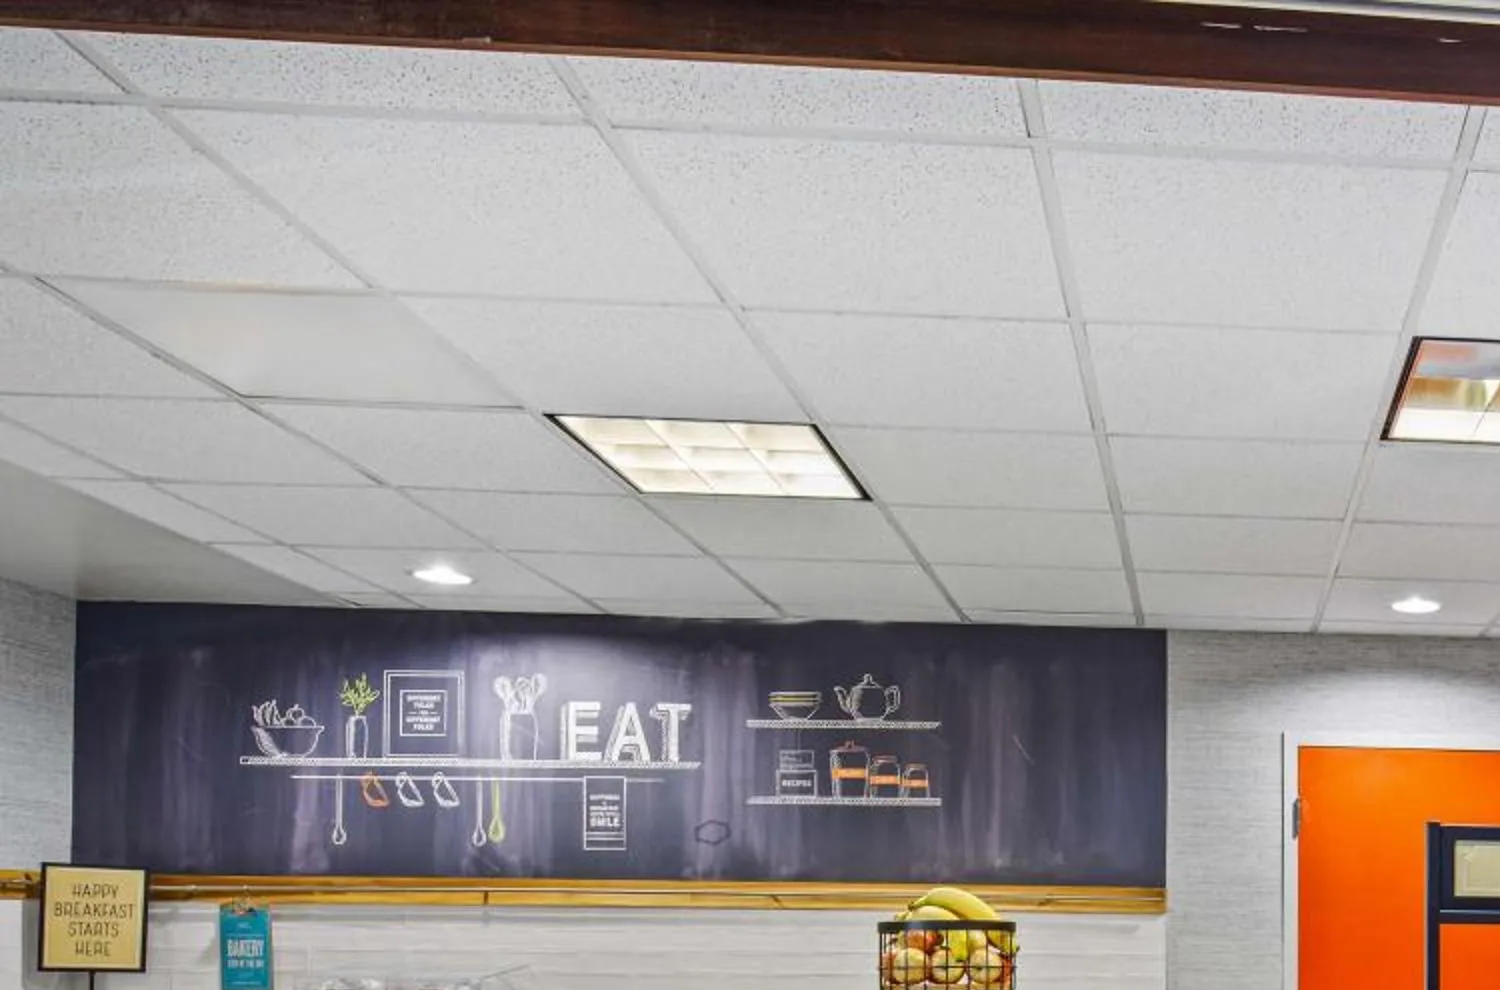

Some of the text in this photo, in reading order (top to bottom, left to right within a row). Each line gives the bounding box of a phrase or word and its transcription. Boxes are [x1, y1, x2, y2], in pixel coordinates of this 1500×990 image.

[560, 701, 692, 763] EAT
[72, 883, 119, 898] HAPPY
[53, 901, 135, 919] BREAKFAST
[67, 921, 119, 938] STARTS
[75, 941, 112, 957] HERE
[227, 938, 265, 957] BAKERY
